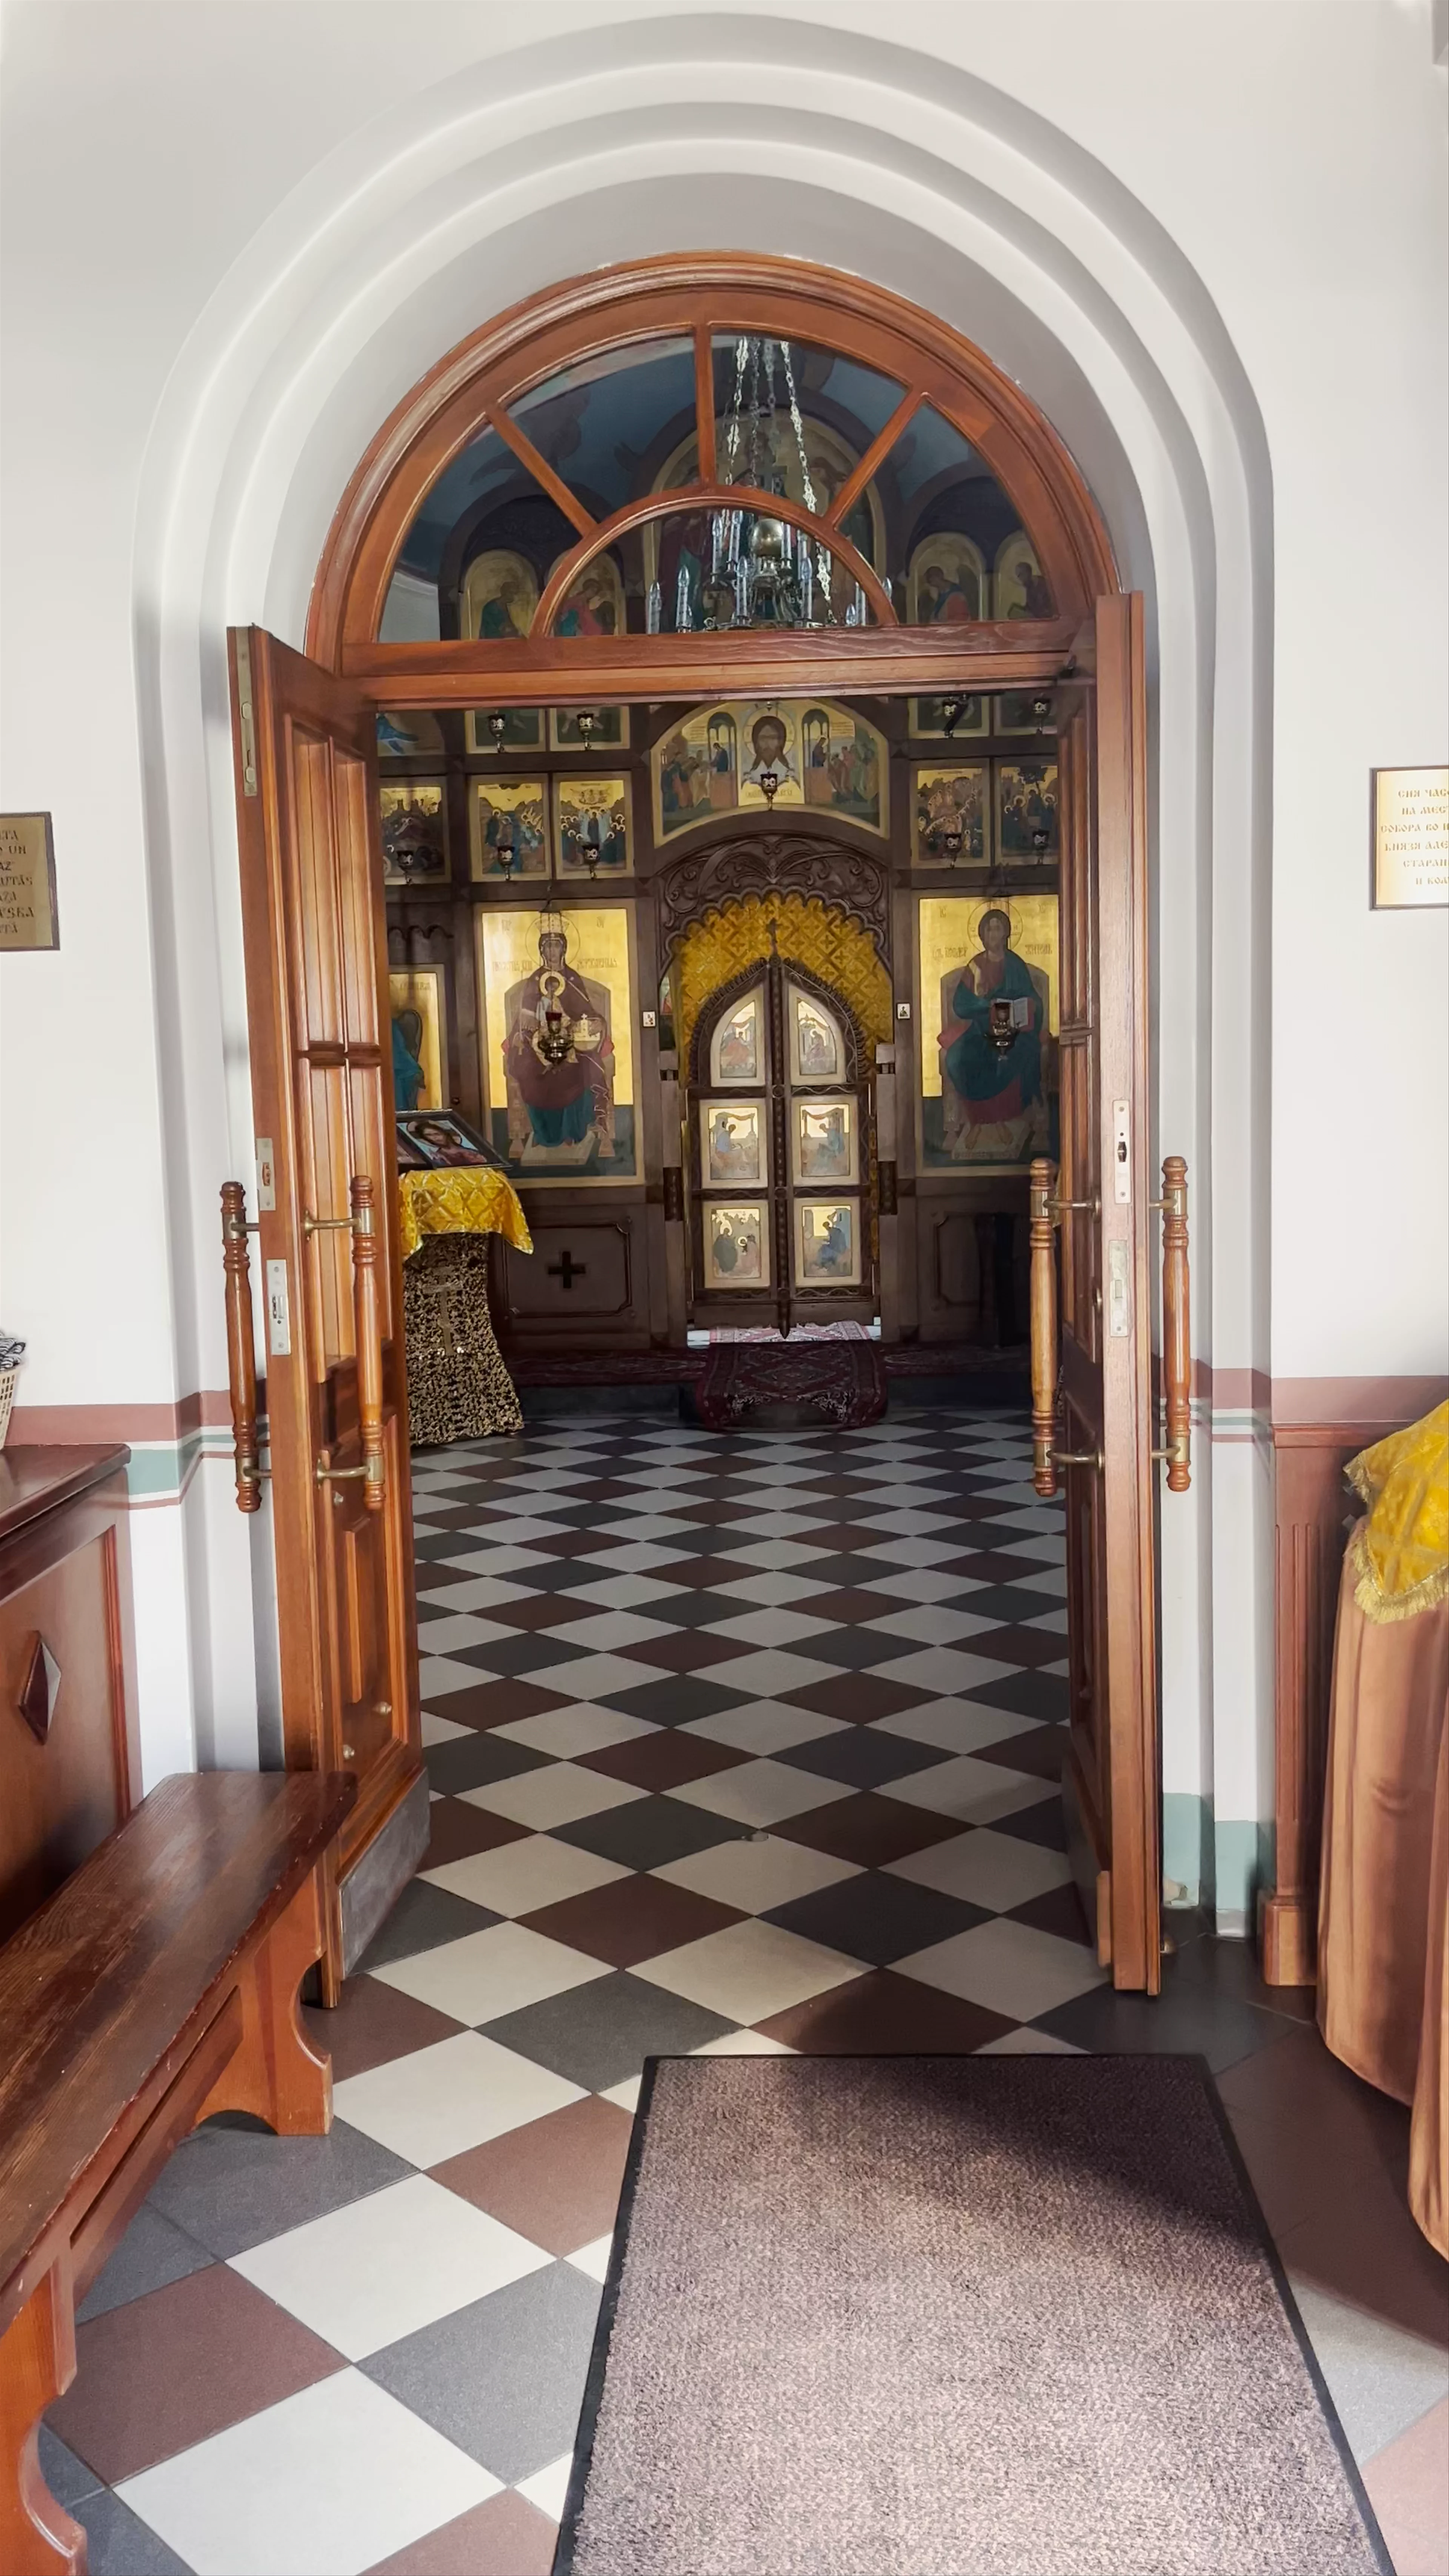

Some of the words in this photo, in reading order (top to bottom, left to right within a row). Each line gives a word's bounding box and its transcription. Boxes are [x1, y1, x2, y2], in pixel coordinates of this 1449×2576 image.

[1425, 788, 1449, 797] ЧАС
[1401, 807, 1416, 815] НА
[1420, 806, 1449, 815] МЕС
[1380, 824, 1421, 833] СОБОРА
[1384, 842, 1421, 851] КНЯЗЯ
